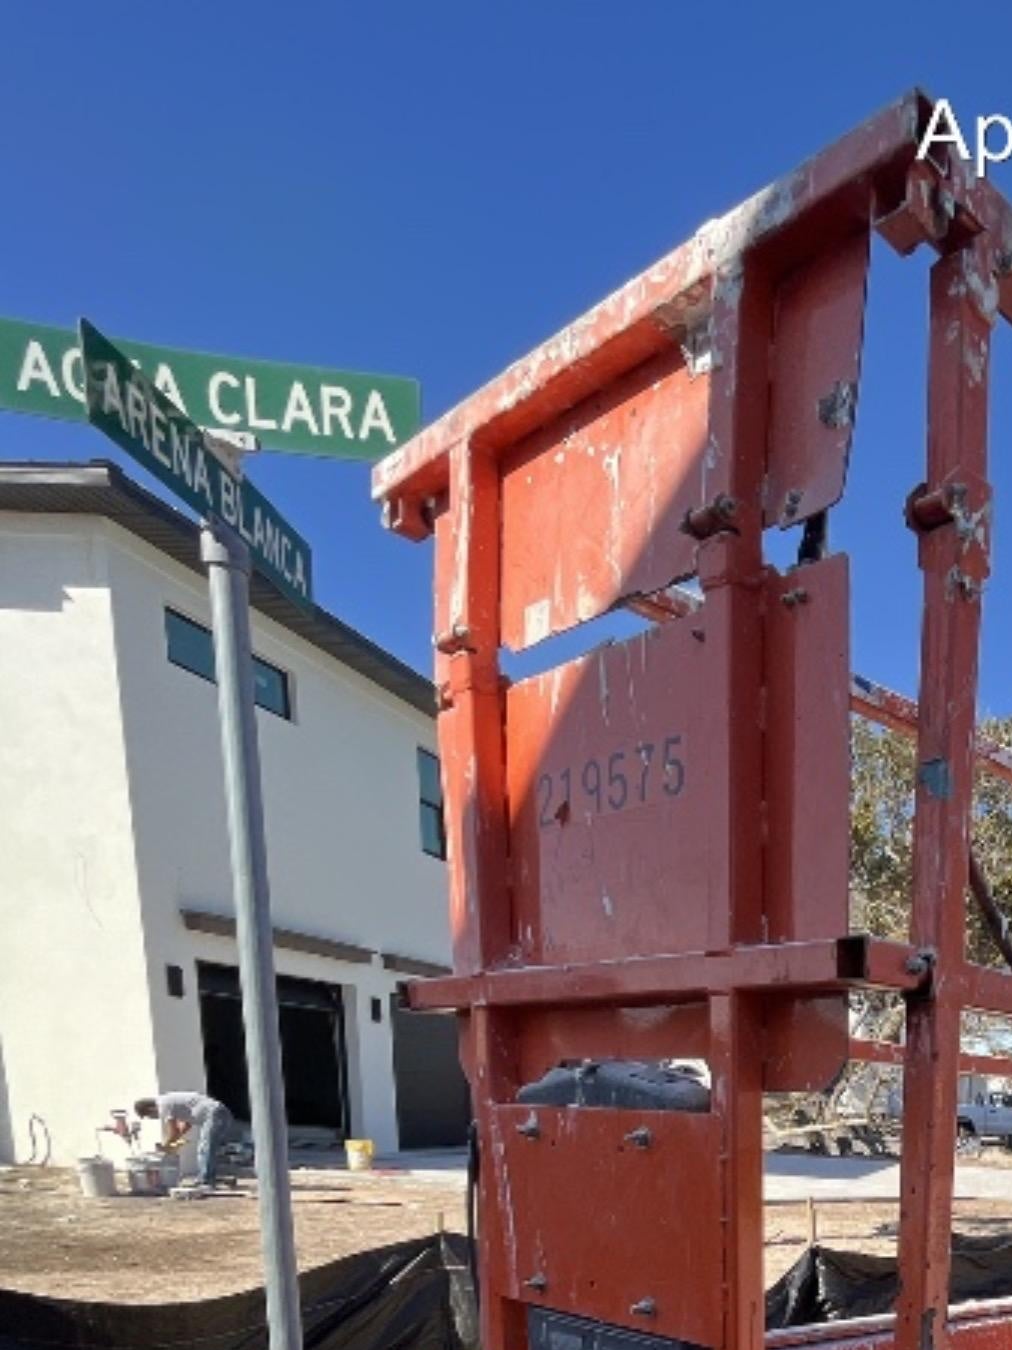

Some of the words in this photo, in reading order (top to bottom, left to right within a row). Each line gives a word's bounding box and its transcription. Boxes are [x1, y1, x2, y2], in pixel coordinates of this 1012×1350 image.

[17, 339, 188, 419] AGA
[208, 370, 397, 444] CLARA
[102, 366, 215, 506] ARENA
[219, 475, 308, 597] BLANCA
[538, 735, 685, 827] 219575
